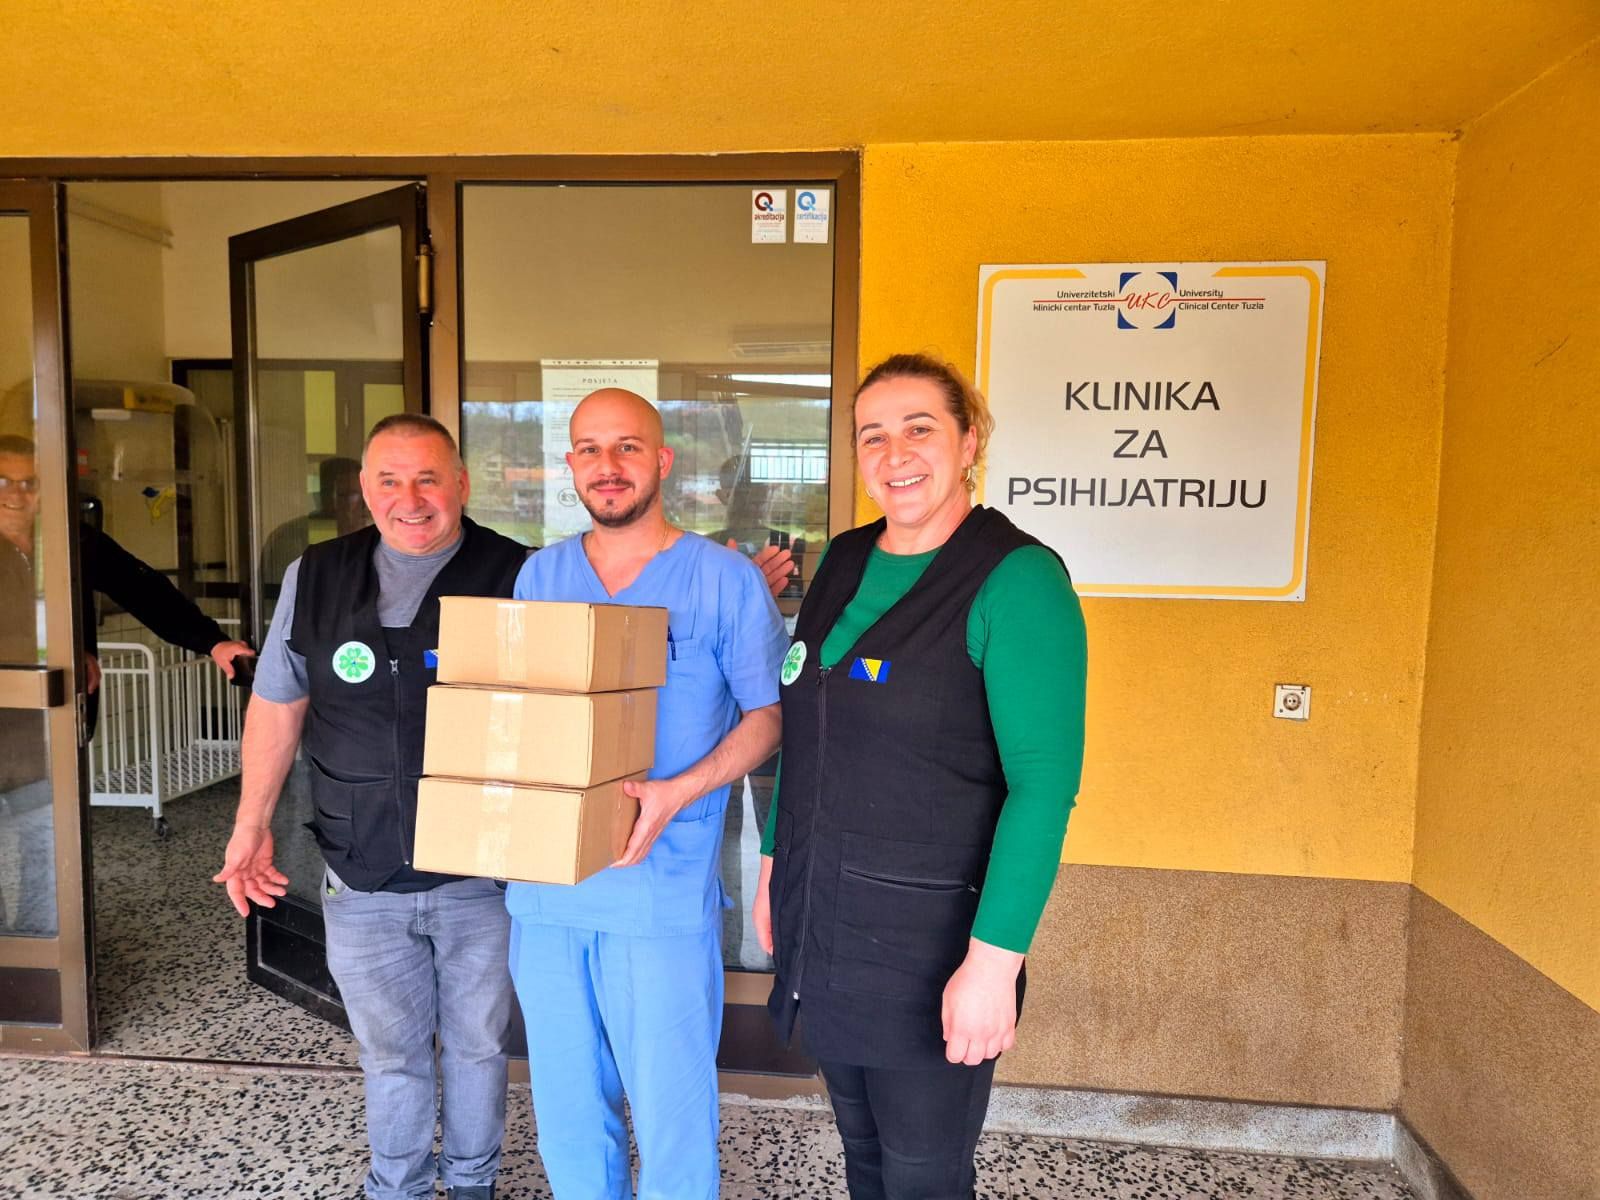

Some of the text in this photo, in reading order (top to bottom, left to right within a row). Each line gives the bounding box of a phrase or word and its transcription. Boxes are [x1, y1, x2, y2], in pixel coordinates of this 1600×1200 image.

[754, 212, 785, 221] akreditacija
[1056, 289, 1116, 299] Univerzitetski
[1179, 289, 1224, 299] University
[1063, 303, 1091, 312] centar
[1093, 303, 1116, 311] Tuzla
[1178, 301, 1265, 311] Clinical Center Tuzla
[1065, 381, 1221, 411] KLINIKA
[1113, 429, 1168, 458] ZA
[1008, 477, 1267, 509] PSIHIJATRIJU
